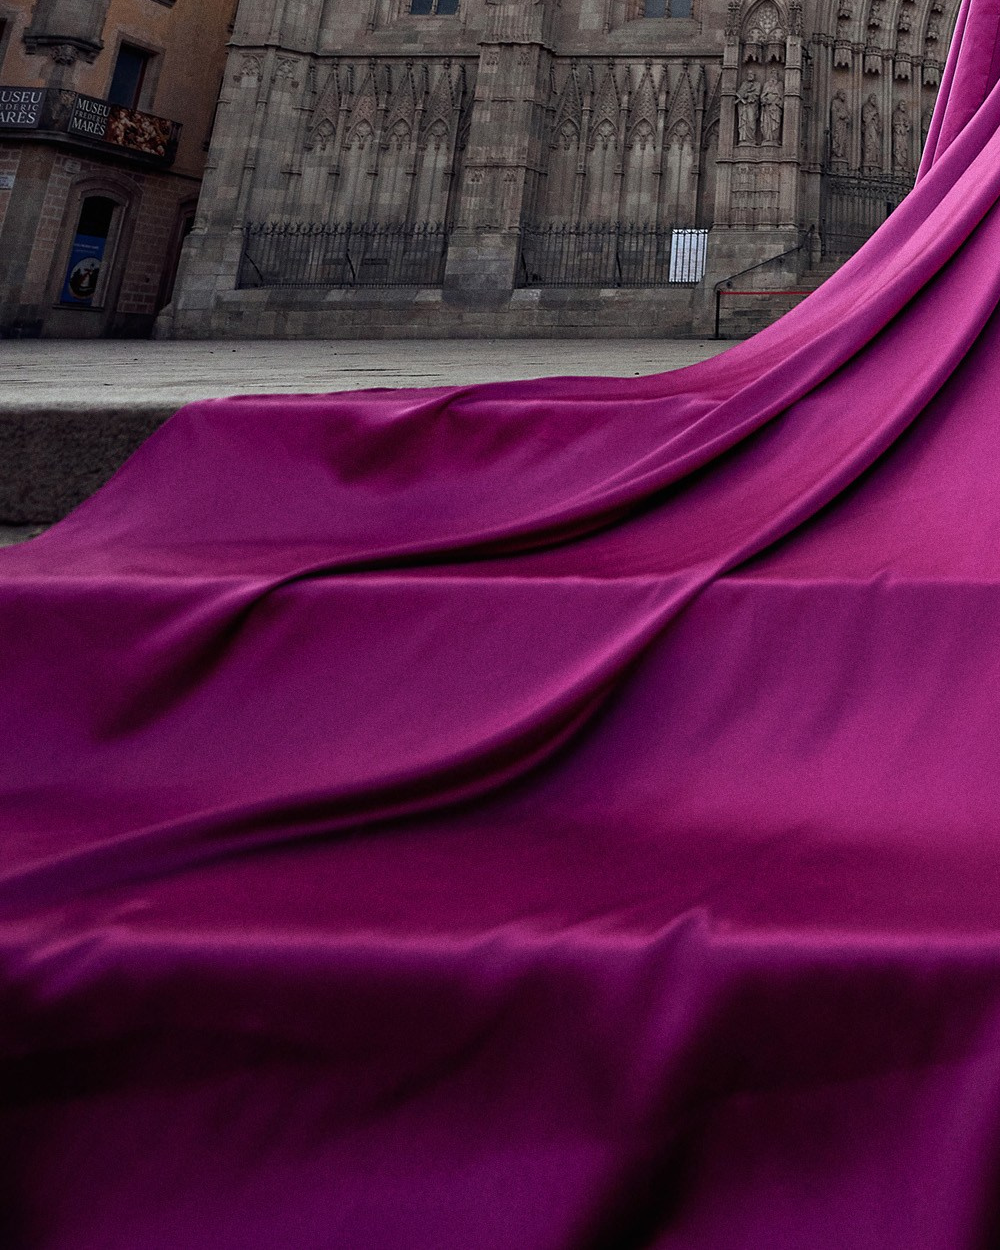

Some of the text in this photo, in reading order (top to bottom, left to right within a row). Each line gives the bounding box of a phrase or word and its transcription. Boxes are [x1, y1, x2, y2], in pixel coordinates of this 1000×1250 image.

[0, 91, 42, 104] USEU
[76, 97, 111, 117] MUSEU
[74, 109, 108, 124] FREDERIC
[71, 116, 106, 136] MARÈS
